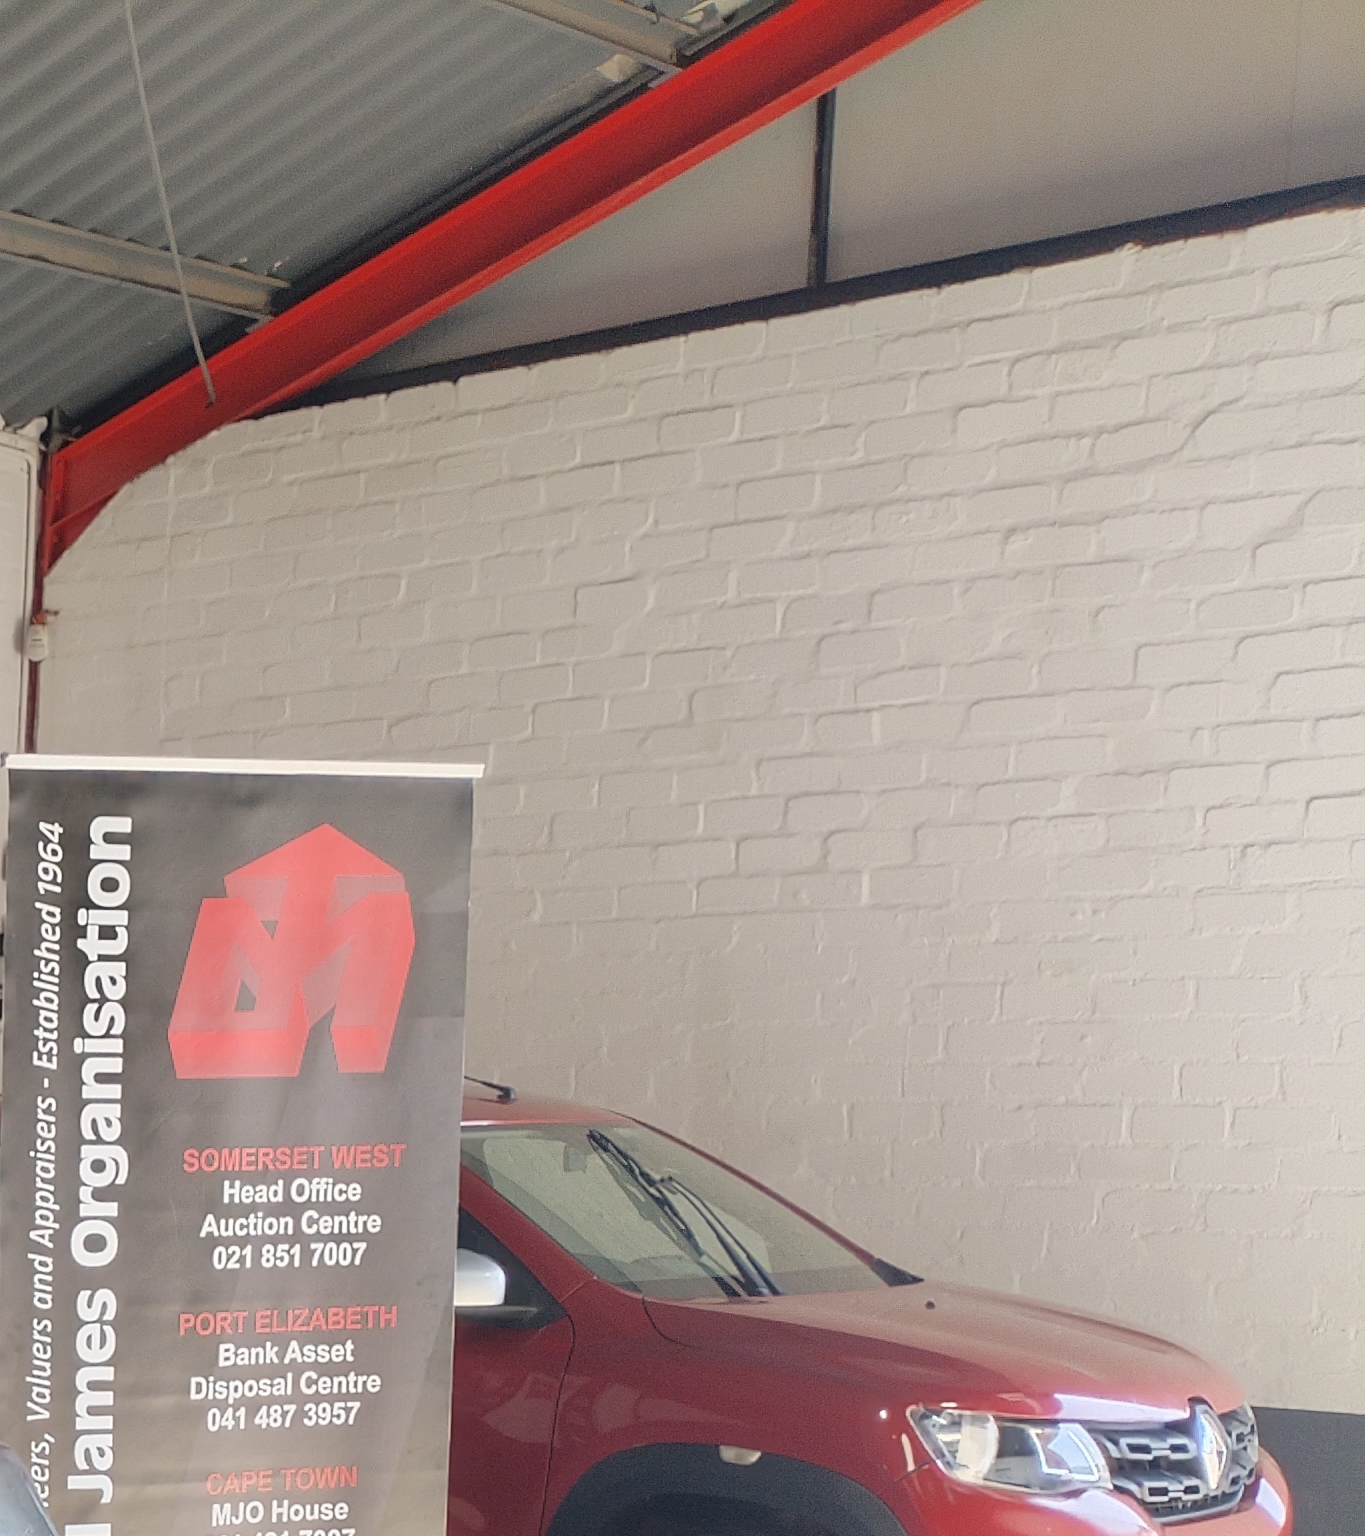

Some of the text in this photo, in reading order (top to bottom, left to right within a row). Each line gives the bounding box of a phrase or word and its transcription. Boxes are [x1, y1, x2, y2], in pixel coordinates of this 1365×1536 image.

[37, 821, 64, 895] 1964
[32, 901, 62, 1070] Established
[70, 815, 133, 1268] Organisation
[29, 1095, 60, 1249] Appraisers
[183, 1144, 407, 1173] SOMERSET WEST
[223, 1177, 362, 1203] Head Office
[199, 1210, 382, 1238] Auction Centre
[212, 1242, 368, 1269] 021 851 7007
[27, 1253, 54, 1309] and
[179, 1305, 398, 1337] PORT ELIZABETH
[218, 1339, 355, 1367] Bank Asset
[25, 1318, 53, 1421] Valuers
[66, 1288, 117, 1504] James
[189, 1371, 382, 1404] Disposal Centre
[207, 1402, 361, 1432] 041 487 3957
[205, 1465, 358, 1495] CAPE TOWN
[211, 1499, 350, 1527] MJO House
